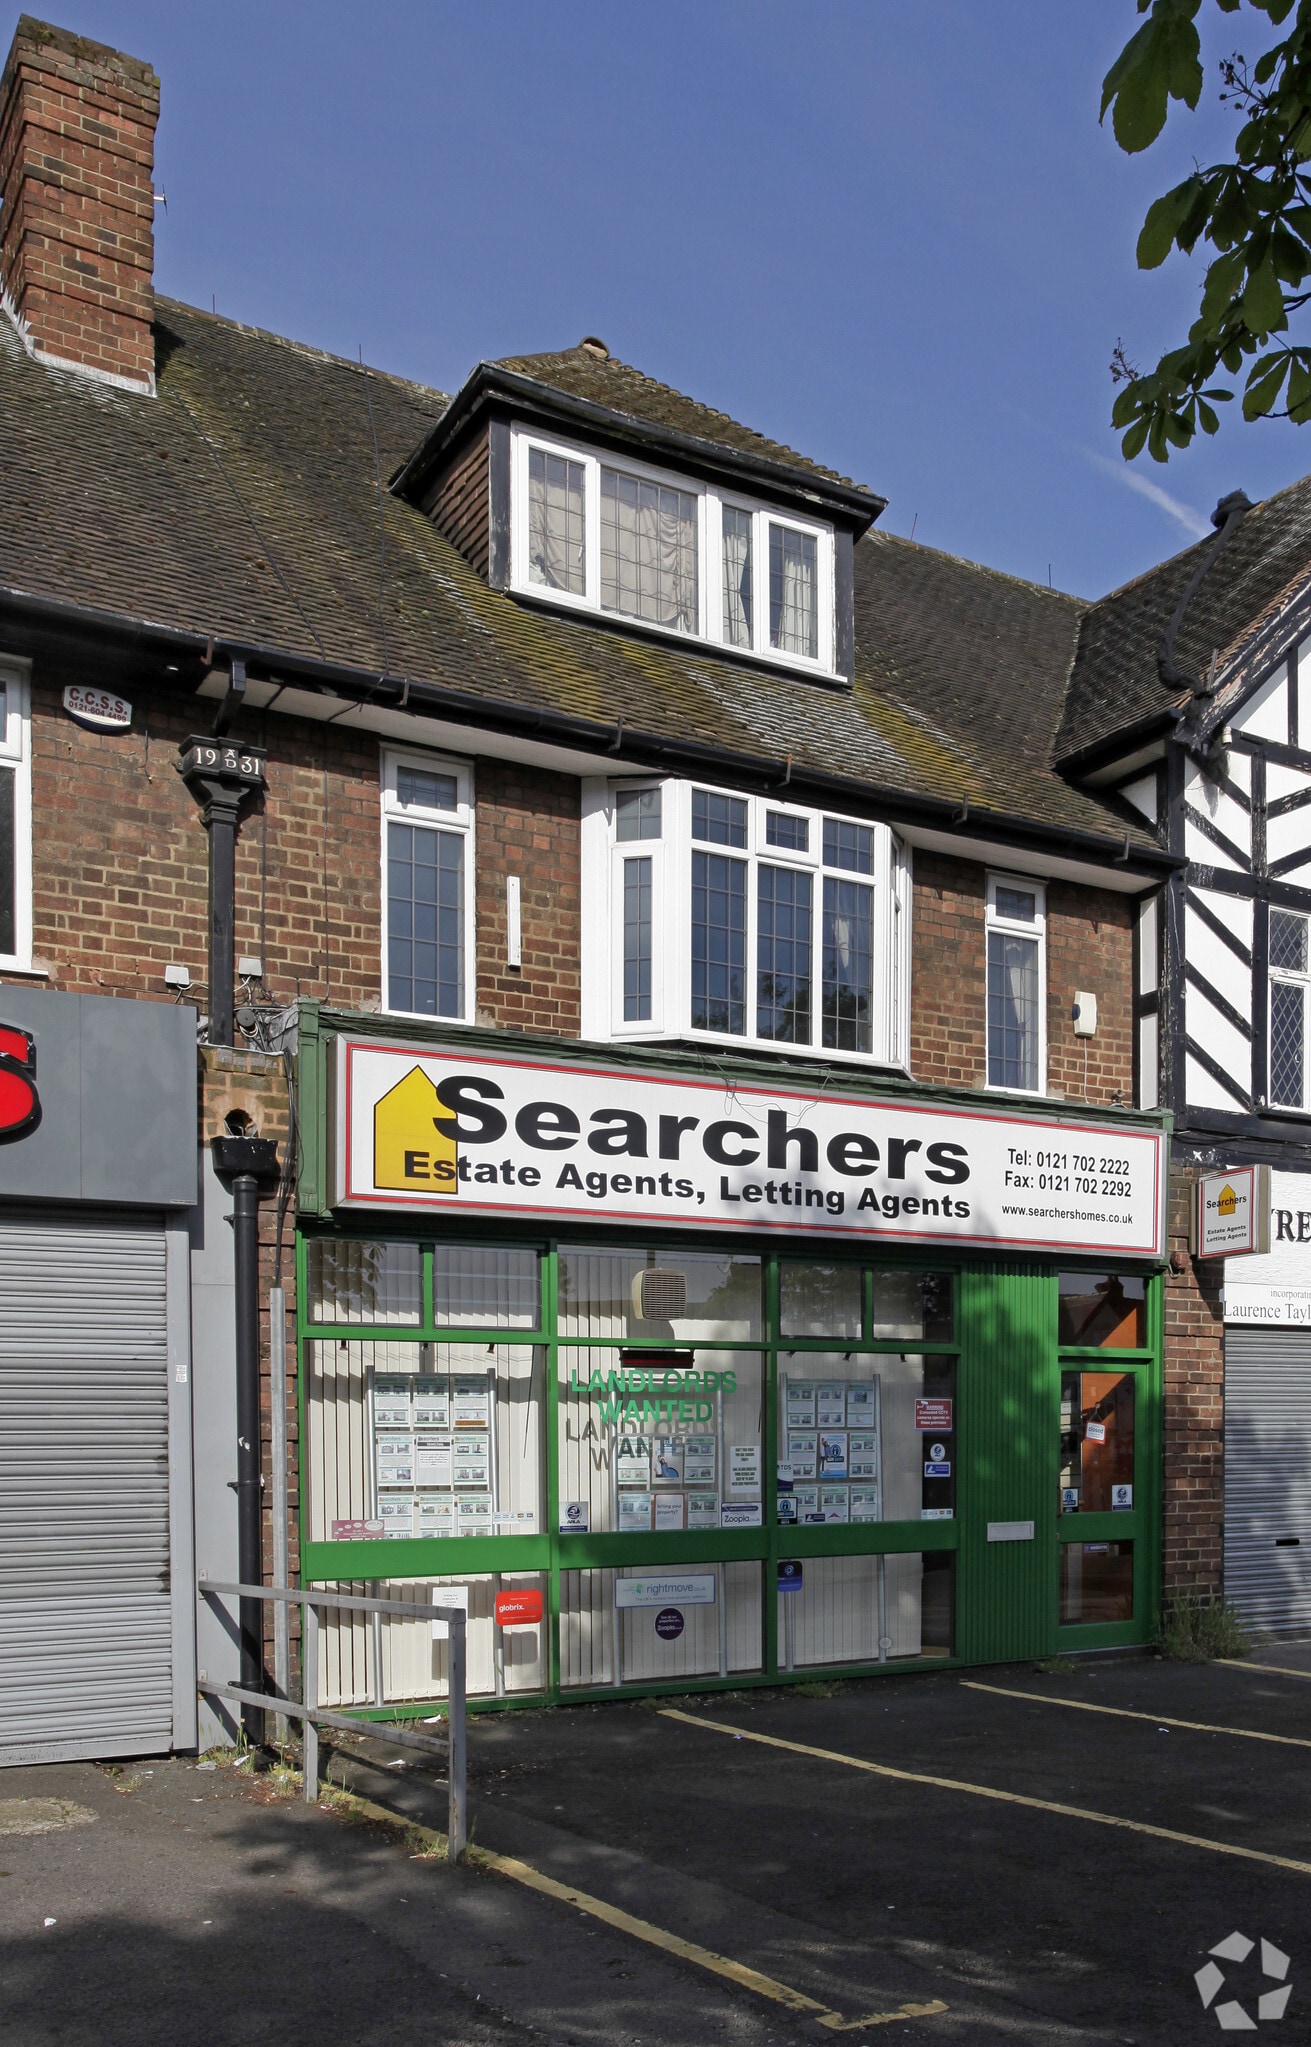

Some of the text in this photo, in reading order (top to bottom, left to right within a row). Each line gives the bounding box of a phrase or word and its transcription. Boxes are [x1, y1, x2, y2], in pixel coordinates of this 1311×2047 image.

[68, 701, 127, 723] 0121-604 4499
[433, 1075, 971, 1185] Searchers
[1007, 1148, 1130, 1176] Tel: 0121 702 2222
[404, 1150, 971, 1220] Estate Agents, Letting Agents
[1004, 1170, 1132, 1197] Fax: 0121 702 2292
[1206, 1195, 1247, 1209] Searchers
[1001, 1205, 1133, 1224] www.searchershomes.co.uk
[1271, 1208, 1311, 1244] RE
[1206, 1232, 1247, 1243] Letting Agents
[1222, 1300, 1281, 1319] Laurence
[571, 1369, 738, 1394] LANDLORDS
[597, 1399, 713, 1423] WANTED
